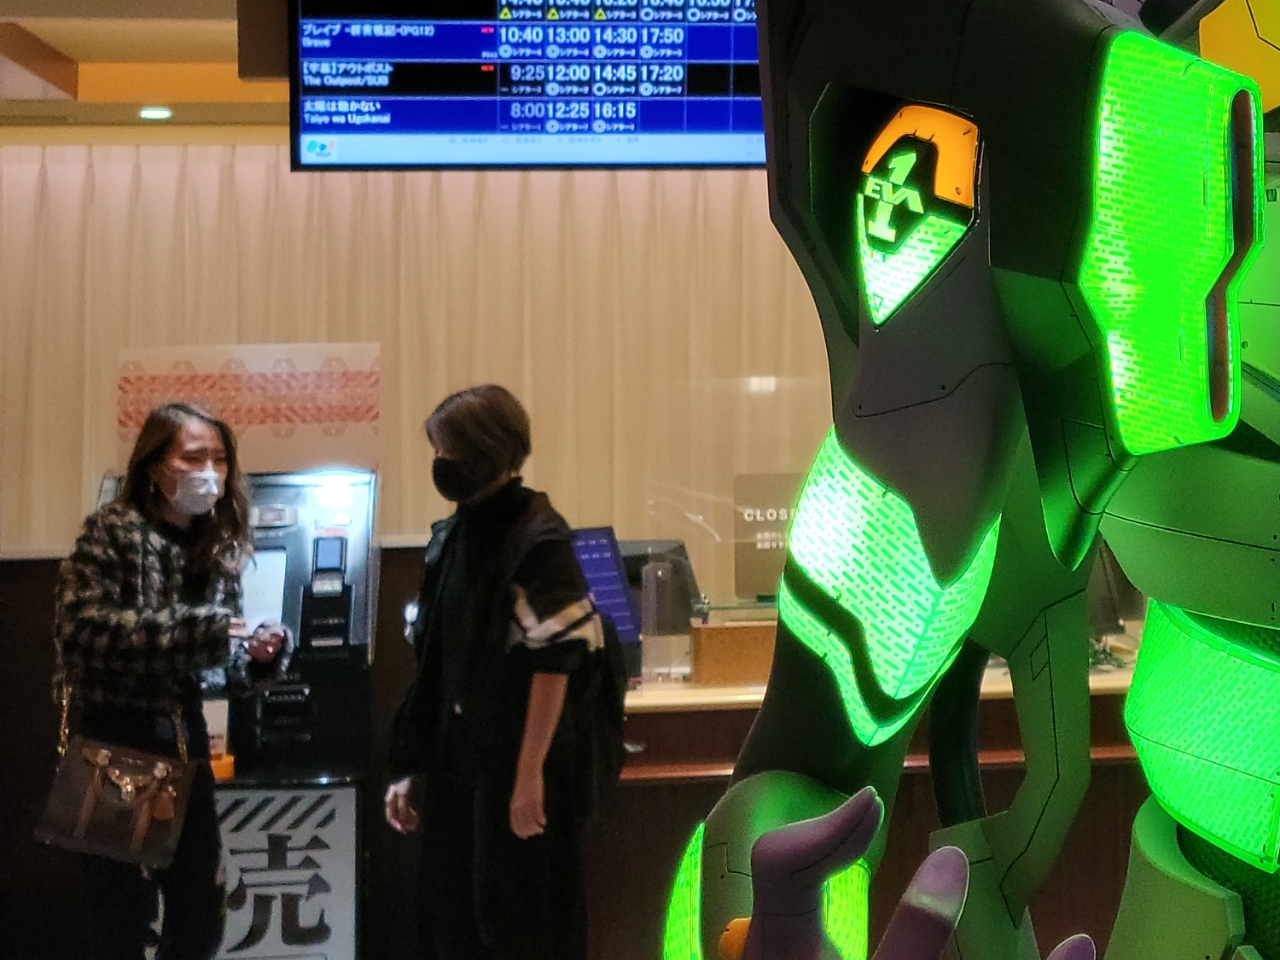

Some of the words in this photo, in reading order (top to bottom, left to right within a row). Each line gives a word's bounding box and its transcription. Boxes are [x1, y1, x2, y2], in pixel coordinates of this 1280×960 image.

[500, 27, 544, 44] 10:40
[547, 27, 590, 44] 13:00
[595, 27, 637, 44] 14:30
[642, 27, 683, 44] 17:50
[510, 65, 546, 82] 9:25
[547, 65, 590, 82] 12:00
[595, 65, 637, 82] 14:45
[642, 65, 683, 82] 17:20
[510, 102, 546, 119] 8:00
[547, 102, 590, 119] 12:25
[595, 102, 637, 119] 16:15
[864, 176, 924, 214] EVA
[743, 508, 791, 522] CLOS
[226, 832, 332, 953] 売
